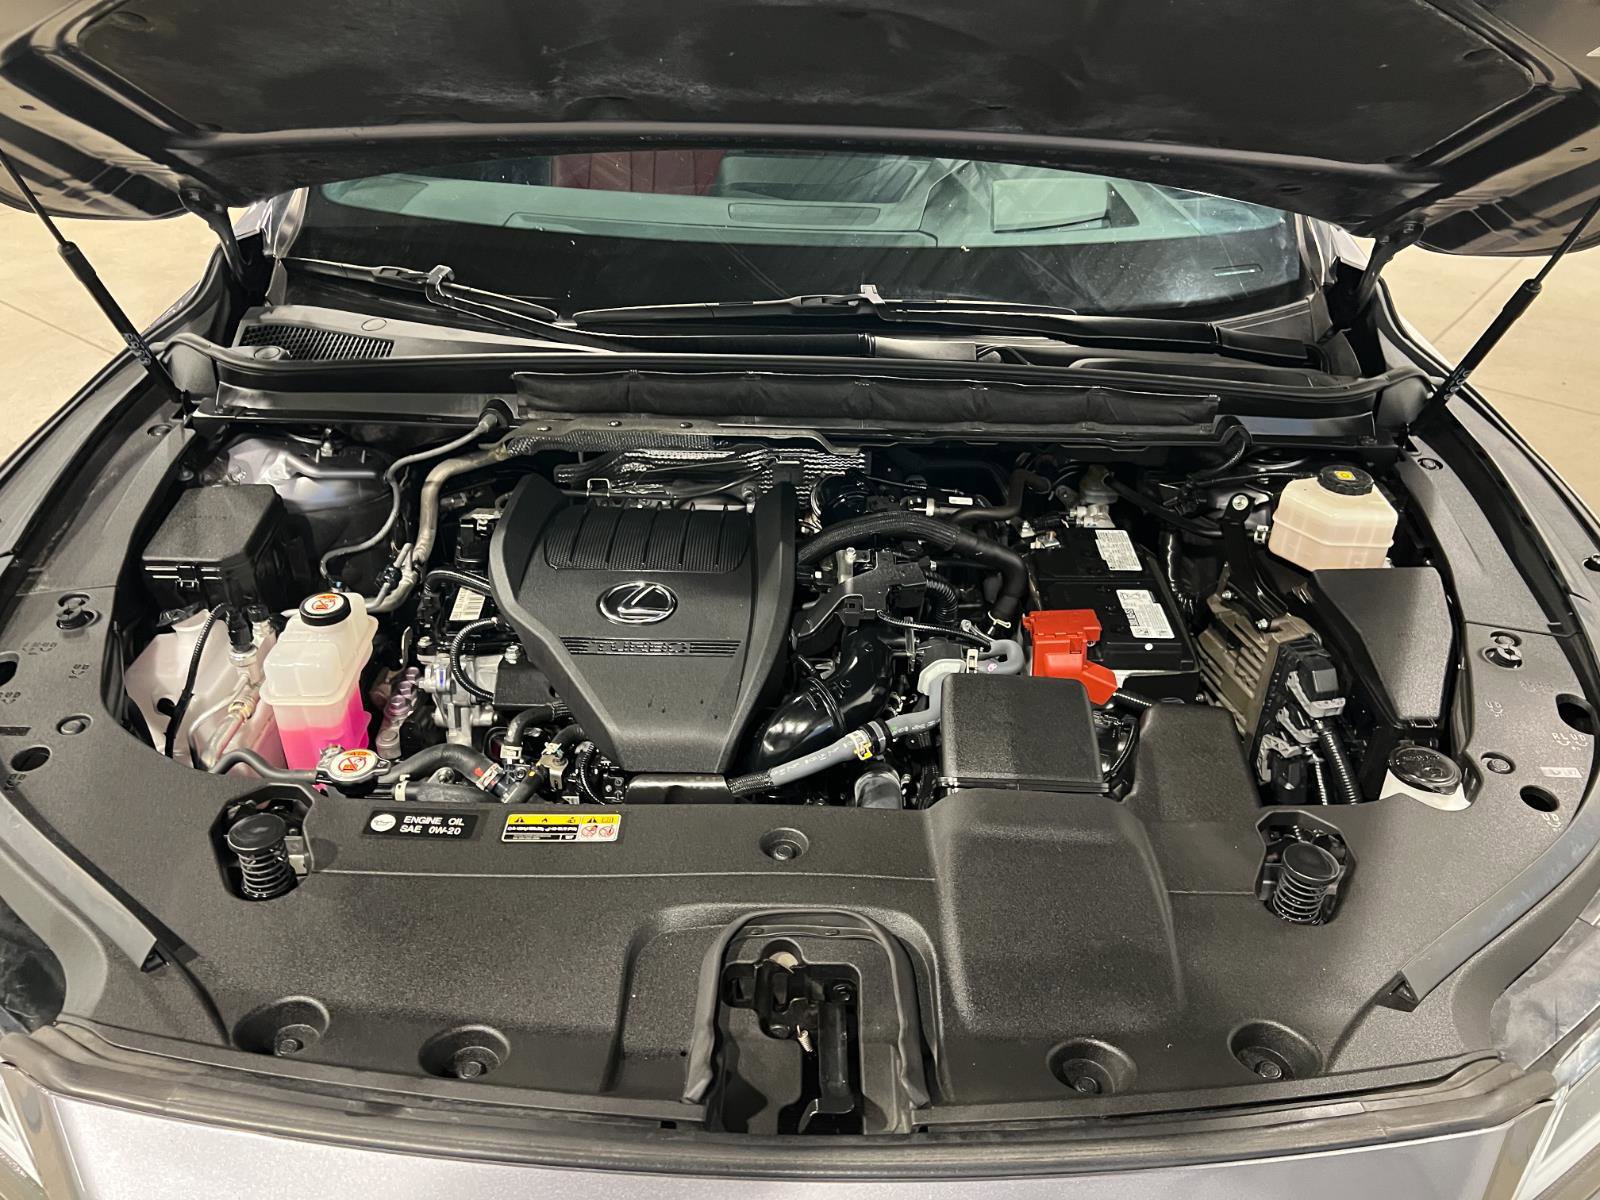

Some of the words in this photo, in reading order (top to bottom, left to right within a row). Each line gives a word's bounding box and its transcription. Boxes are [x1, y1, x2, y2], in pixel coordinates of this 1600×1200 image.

[591, 640, 687, 653] TURBO
[403, 815, 443, 824] ENGINE
[447, 817, 465, 826] OIL
[399, 824, 422, 833] SAE
[428, 826, 462, 835] 0W-20
